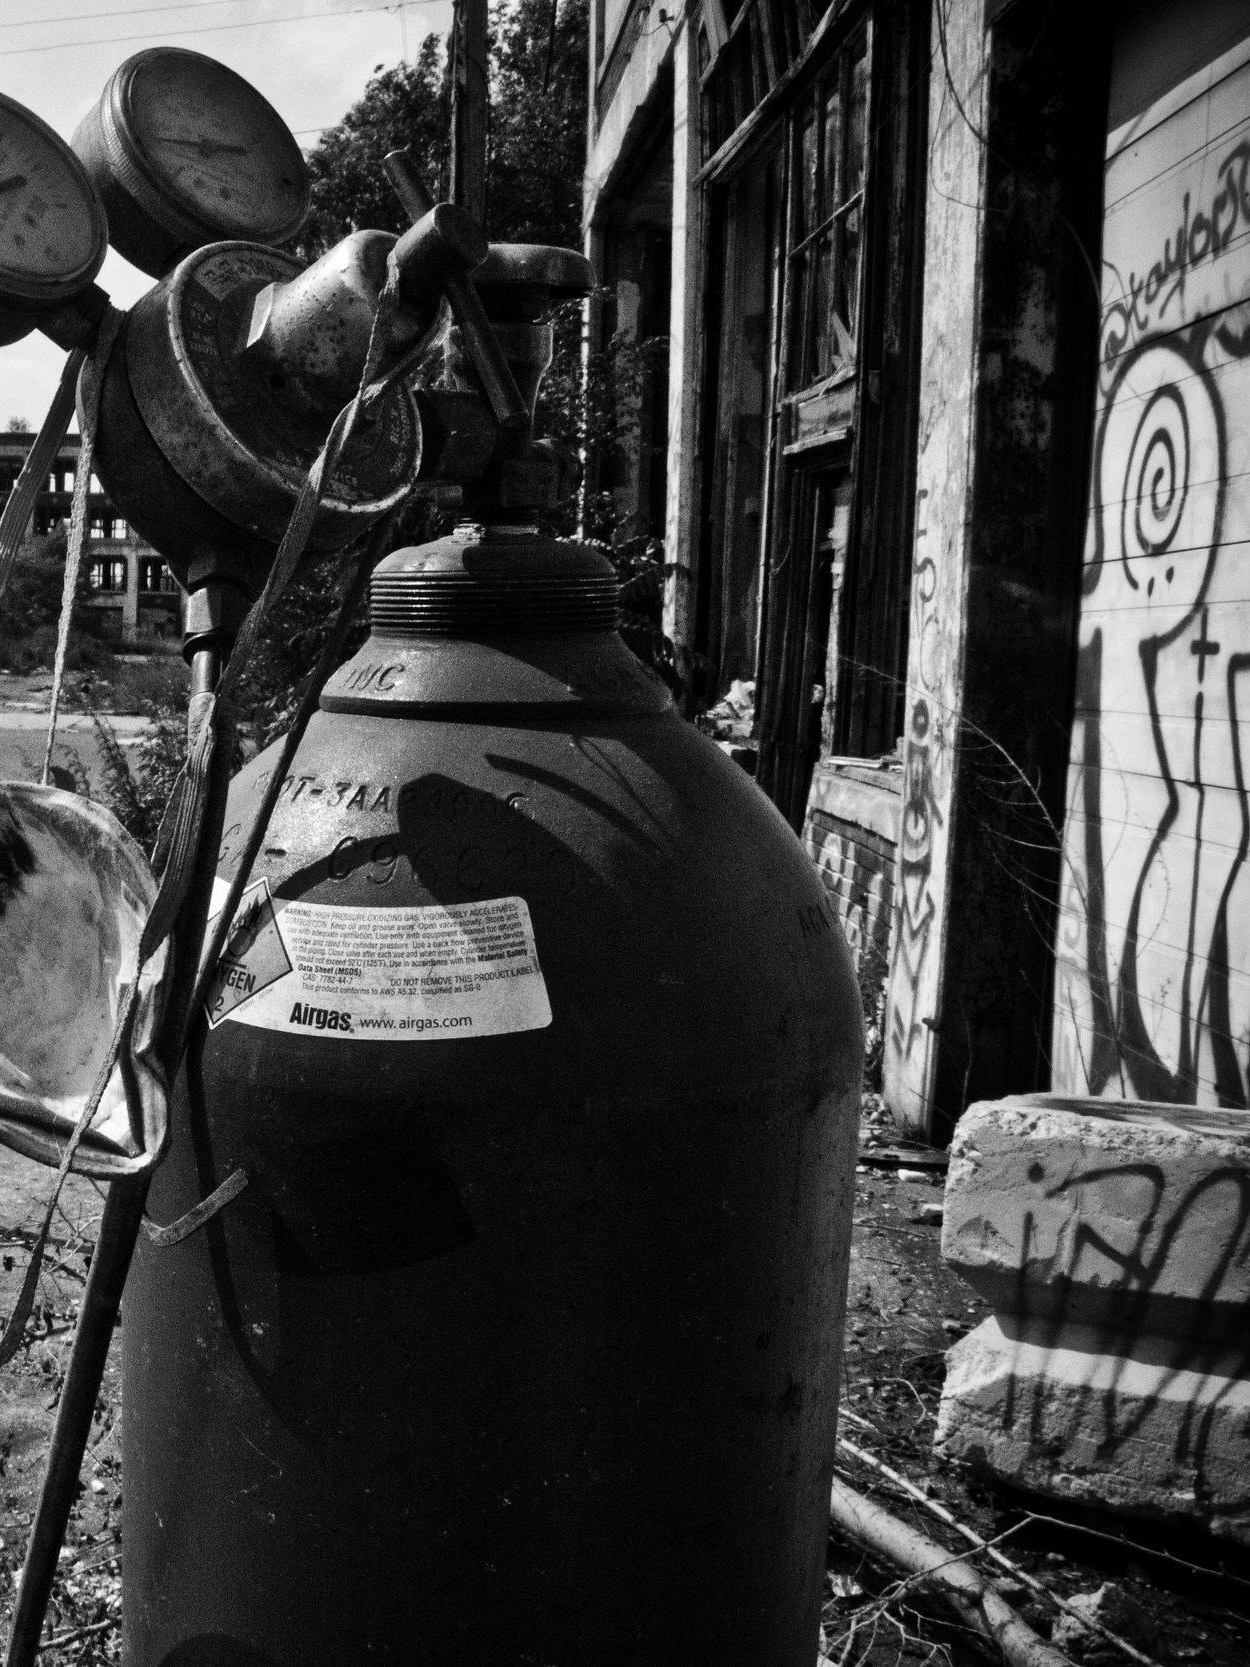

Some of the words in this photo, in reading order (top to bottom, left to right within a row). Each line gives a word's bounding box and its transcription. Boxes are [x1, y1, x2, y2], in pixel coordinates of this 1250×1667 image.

[284, 907, 312, 917] WARNING:
[314, 910, 330, 919] HIGH
[331, 911, 365, 921] PRESSURE
[368, 914, 402, 922] OXIDIZING
[423, 910, 467, 921] VIGOROUSLY
[470, 904, 517, 917] ACCELERATES
[285, 917, 328, 928] COMBUSTION.
[331, 922, 346, 931] Keep
[348, 922, 356, 930] oil
[358, 923, 370, 931] and
[372, 924, 394, 932] grease
[396, 924, 415, 932] away.
[418, 922, 437, 931] Open
[439, 921, 457, 929] valve
[459, 918, 482, 928] slowly.
[486, 915, 505, 924] Store
[506, 912, 519, 921] and
[312, 929, 338, 939] adequate
[340, 931, 373, 940] ventilation.
[375, 932, 388, 940] Use
[389, 933, 404, 941] only
[406, 931, 420, 939] with
[422, 930, 458, 940] equipment
[460, 927, 485, 936] cleaned
[487, 925, 497, 933] for
[498, 921, 522, 932] oxygen
[325, 940, 341, 948] rated
[342, 940, 351, 948] for
[352, 941, 378, 950] cylinder
[379, 942, 409, 951] pressure.
[412, 940, 426, 949] Use
[433, 940, 449, 948] back
[451, 938, 466, 947] flow
[467, 935, 502, 946] preventive
[503, 930, 525, 940] device
[295, 954, 314, 962] should
[315, 956, 325, 964] not
[326, 957, 347, 965] exceed
[390, 959, 402, 968] Use
[411, 959, 448, 967] accordance
[450, 957, 464, 965] with
[465, 956, 476, 964] the
[477, 951, 505, 962] Material
[506, 948, 528, 959] Safety
[328, 948, 345, 956] Close
[346, 950, 361, 958] valve
[377, 951, 392, 959] each
[406, 950, 418, 958] and
[419, 950, 437, 958] when
[438, 948, 458, 958] empty.
[460, 945, 487, 955] Cylinder
[488, 940, 526, 952] temperature
[298, 963, 313, 973] Data
[314, 965, 334, 974] Sheet
[334, 968, 362, 977] (MSDS)
[403, 977, 419, 987] NOT
[420, 976, 453, 986] REMOVE
[454, 974, 472, 984] THIS
[474, 969, 509, 981] PRODUCT
[511, 965, 534, 977] LABEL
[302, 982, 314, 991] This
[315, 984, 339, 994] product
[340, 987, 370, 995] conforms
[371, 987, 378, 995] to
[379, 987, 395, 996] AWS
[421, 985, 453, 995] classified
[320, 975, 353, 985] 7782-44-7
[214, 996, 225, 1013] 2
